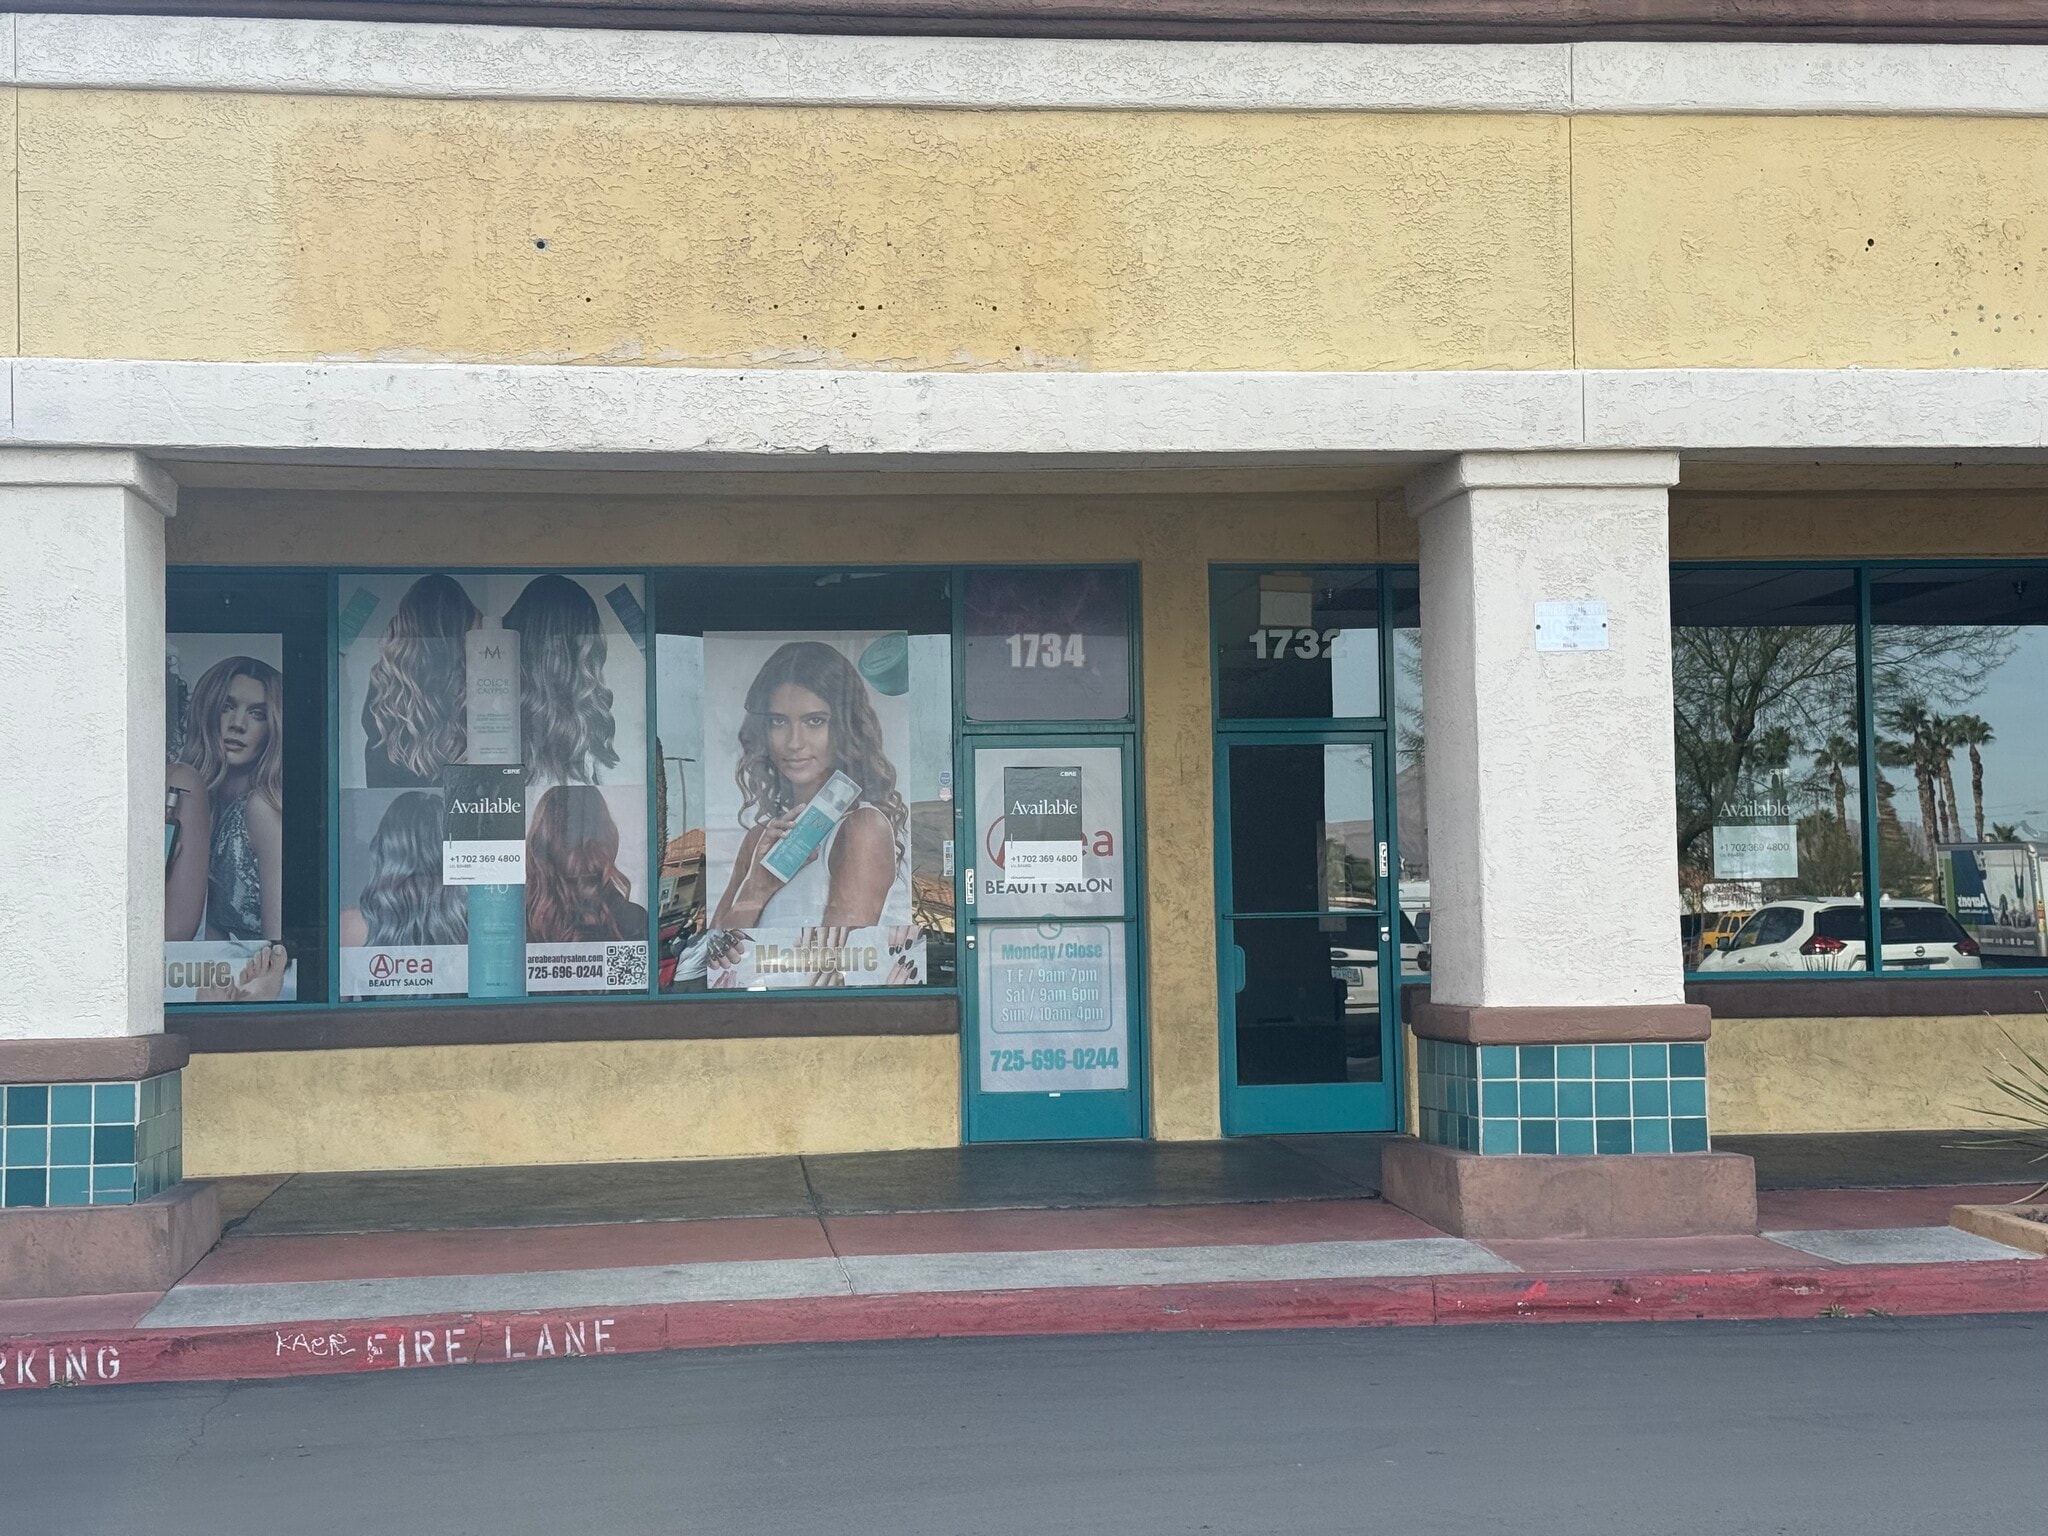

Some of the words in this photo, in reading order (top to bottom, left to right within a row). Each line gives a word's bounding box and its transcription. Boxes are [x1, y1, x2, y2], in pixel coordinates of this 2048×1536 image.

[1006, 633, 1086, 667] 1734
[1249, 629, 1345, 659] 1732
[449, 797, 521, 814] Available
[1010, 799, 1078, 815] Available
[1718, 799, 1791, 817] Available
[1730, 843, 1747, 852] 702
[1748, 843, 1764, 851] 369
[1766, 842, 1790, 851] 4800
[461, 855, 477, 863] 702
[479, 855, 495, 863] 369
[497, 854, 521, 863] 4800
[1022, 855, 1037, 863] 702
[1039, 855, 1054, 863] 369
[1056, 855, 1078, 863] 4800
[1055, 878, 1113, 893] SALON
[527, 954, 604, 964] areabeautysalon.com
[755, 941, 878, 974] Manicure
[1001, 944, 1056, 961] Monday
[1057, 943, 1064, 959] /
[1065, 943, 1103, 958] Close
[164, 956, 232, 988] cure
[369, 953, 433, 979] Area
[528, 965, 603, 979] 725-696-0244
[369, 979, 401, 987] BEAUTY
[404, 978, 433, 987] SALON
[1007, 969, 1024, 983] T-F
[1028, 969, 1034, 983] /
[1006, 988, 1025, 1003] Sat
[1030, 988, 1035, 1002] /
[1002, 1007, 1025, 1022] Sun
[1029, 1007, 1035, 1021] /
[990, 1046, 1119, 1072] 725-696-0244
[368, 1329, 467, 1367] FIRE
[505, 1319, 616, 1358] LANE
